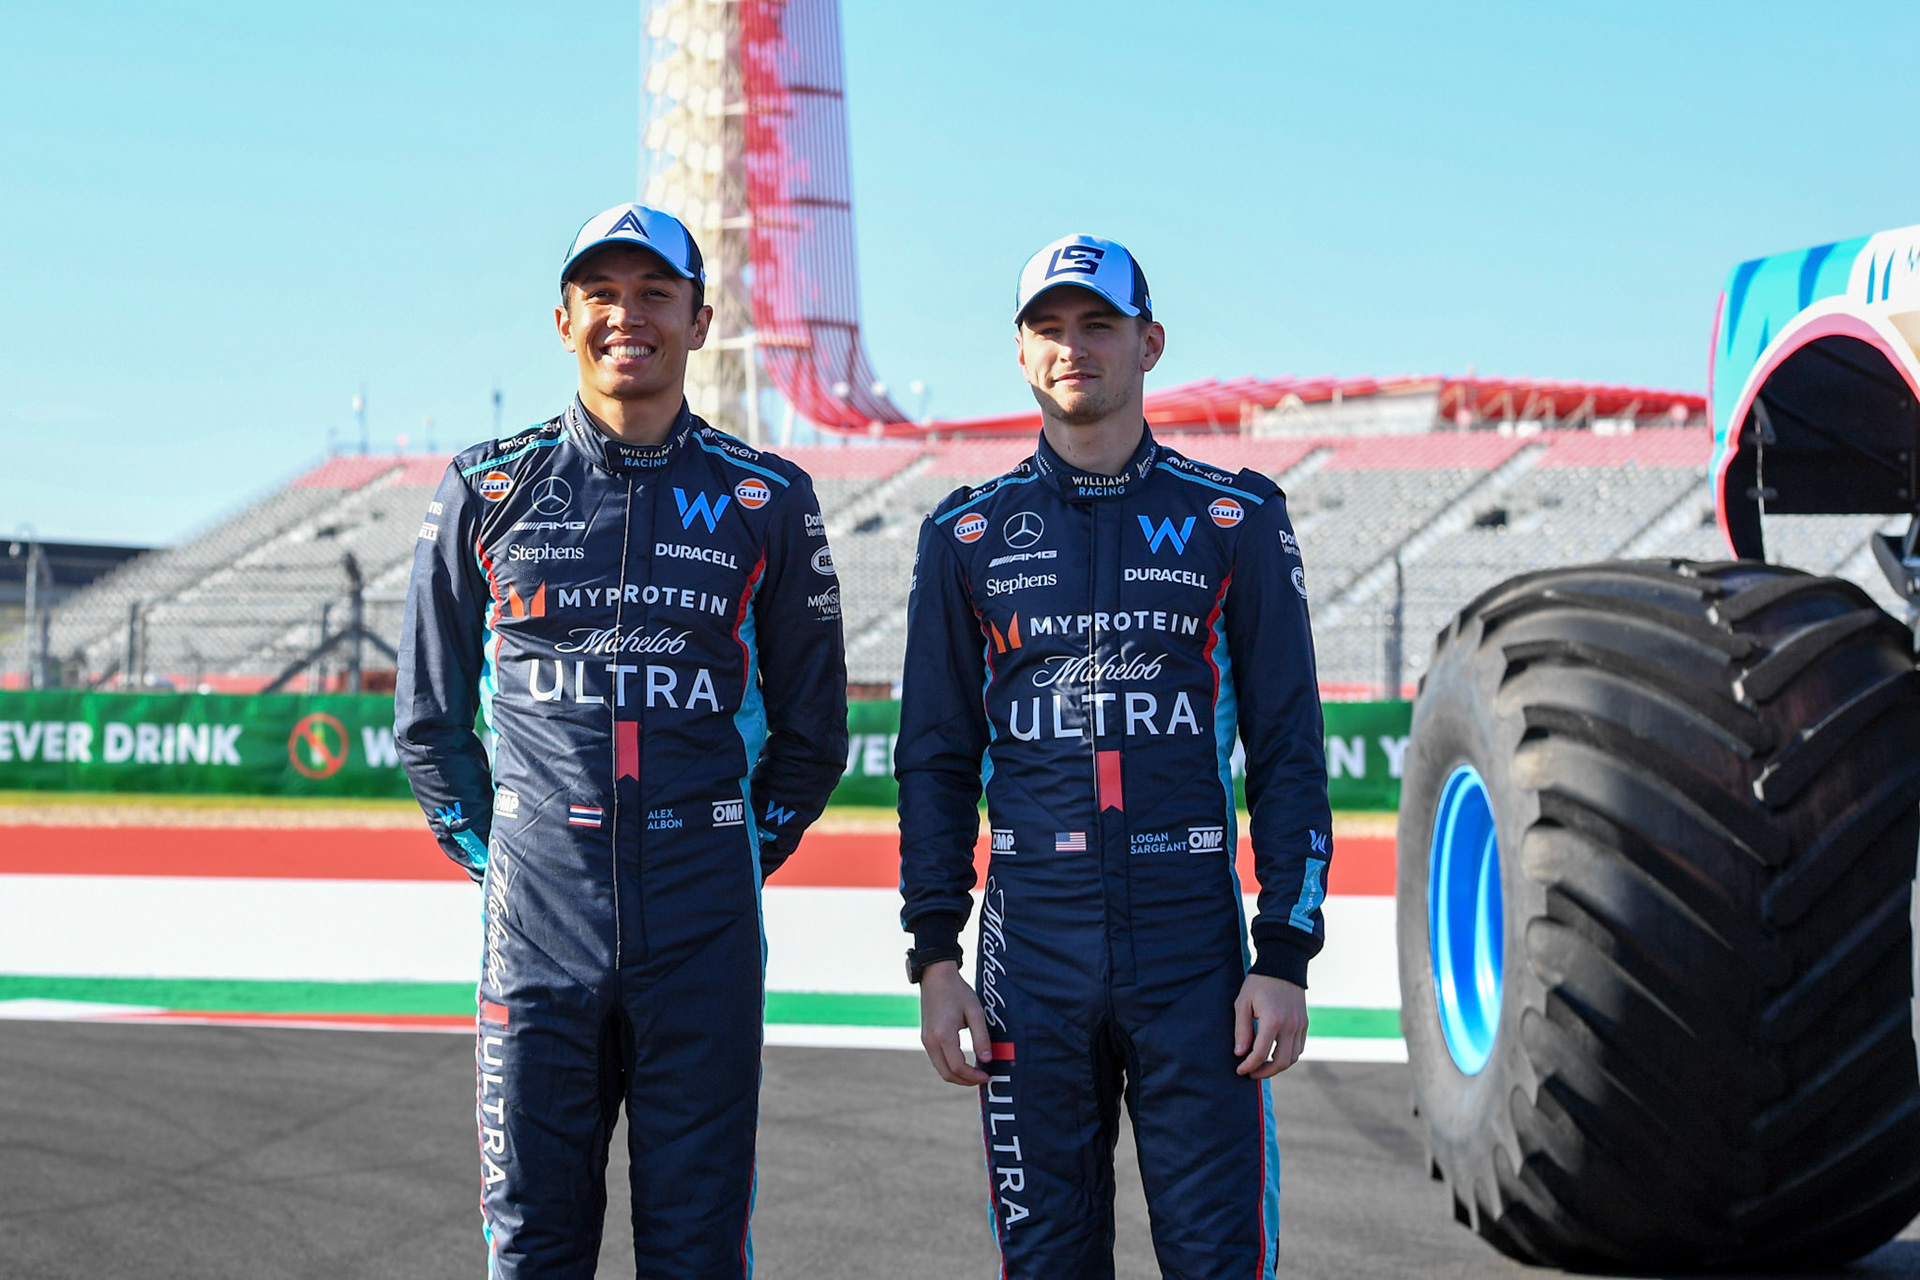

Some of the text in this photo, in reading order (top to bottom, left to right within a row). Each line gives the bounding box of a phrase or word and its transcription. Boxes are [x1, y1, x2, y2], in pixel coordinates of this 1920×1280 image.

[479, 482, 511, 492] Gulf
[1071, 472, 1131, 486] WILLIAMS
[737, 488, 769, 499] Gulf
[1078, 486, 1125, 496] RACING
[1210, 505, 1243, 518] Gulf
[536, 521, 586, 530] AMG
[955, 521, 987, 535] Gulf
[507, 543, 585, 563] Stephens
[655, 542, 738, 570] DURACELL
[1011, 550, 1057, 562] AMG
[986, 573, 1058, 598] Stephens
[1124, 568, 1208, 590] DURACELL
[558, 584, 728, 616] MYPROTEIN
[1029, 611, 1199, 637] MYPROTEIN
[555, 626, 693, 656] Michelob
[1032, 653, 1168, 688] Michelob
[528, 659, 724, 713] ULTRA
[1009, 692, 1204, 741] ULTRA
[647, 809, 674, 820] ALEX
[712, 805, 745, 822] OMP
[647, 819, 683, 830] ALBON
[1130, 832, 1170, 843] LOGAN
[1189, 830, 1224, 849] OMP
[1130, 842, 1188, 854] SARGEANT
[486, 838, 510, 996] Michelob
[982, 876, 1007, 1032] Michelob
[482, 1036, 507, 1191] ULTRA
[988, 1075, 1031, 1231] ULTRA
